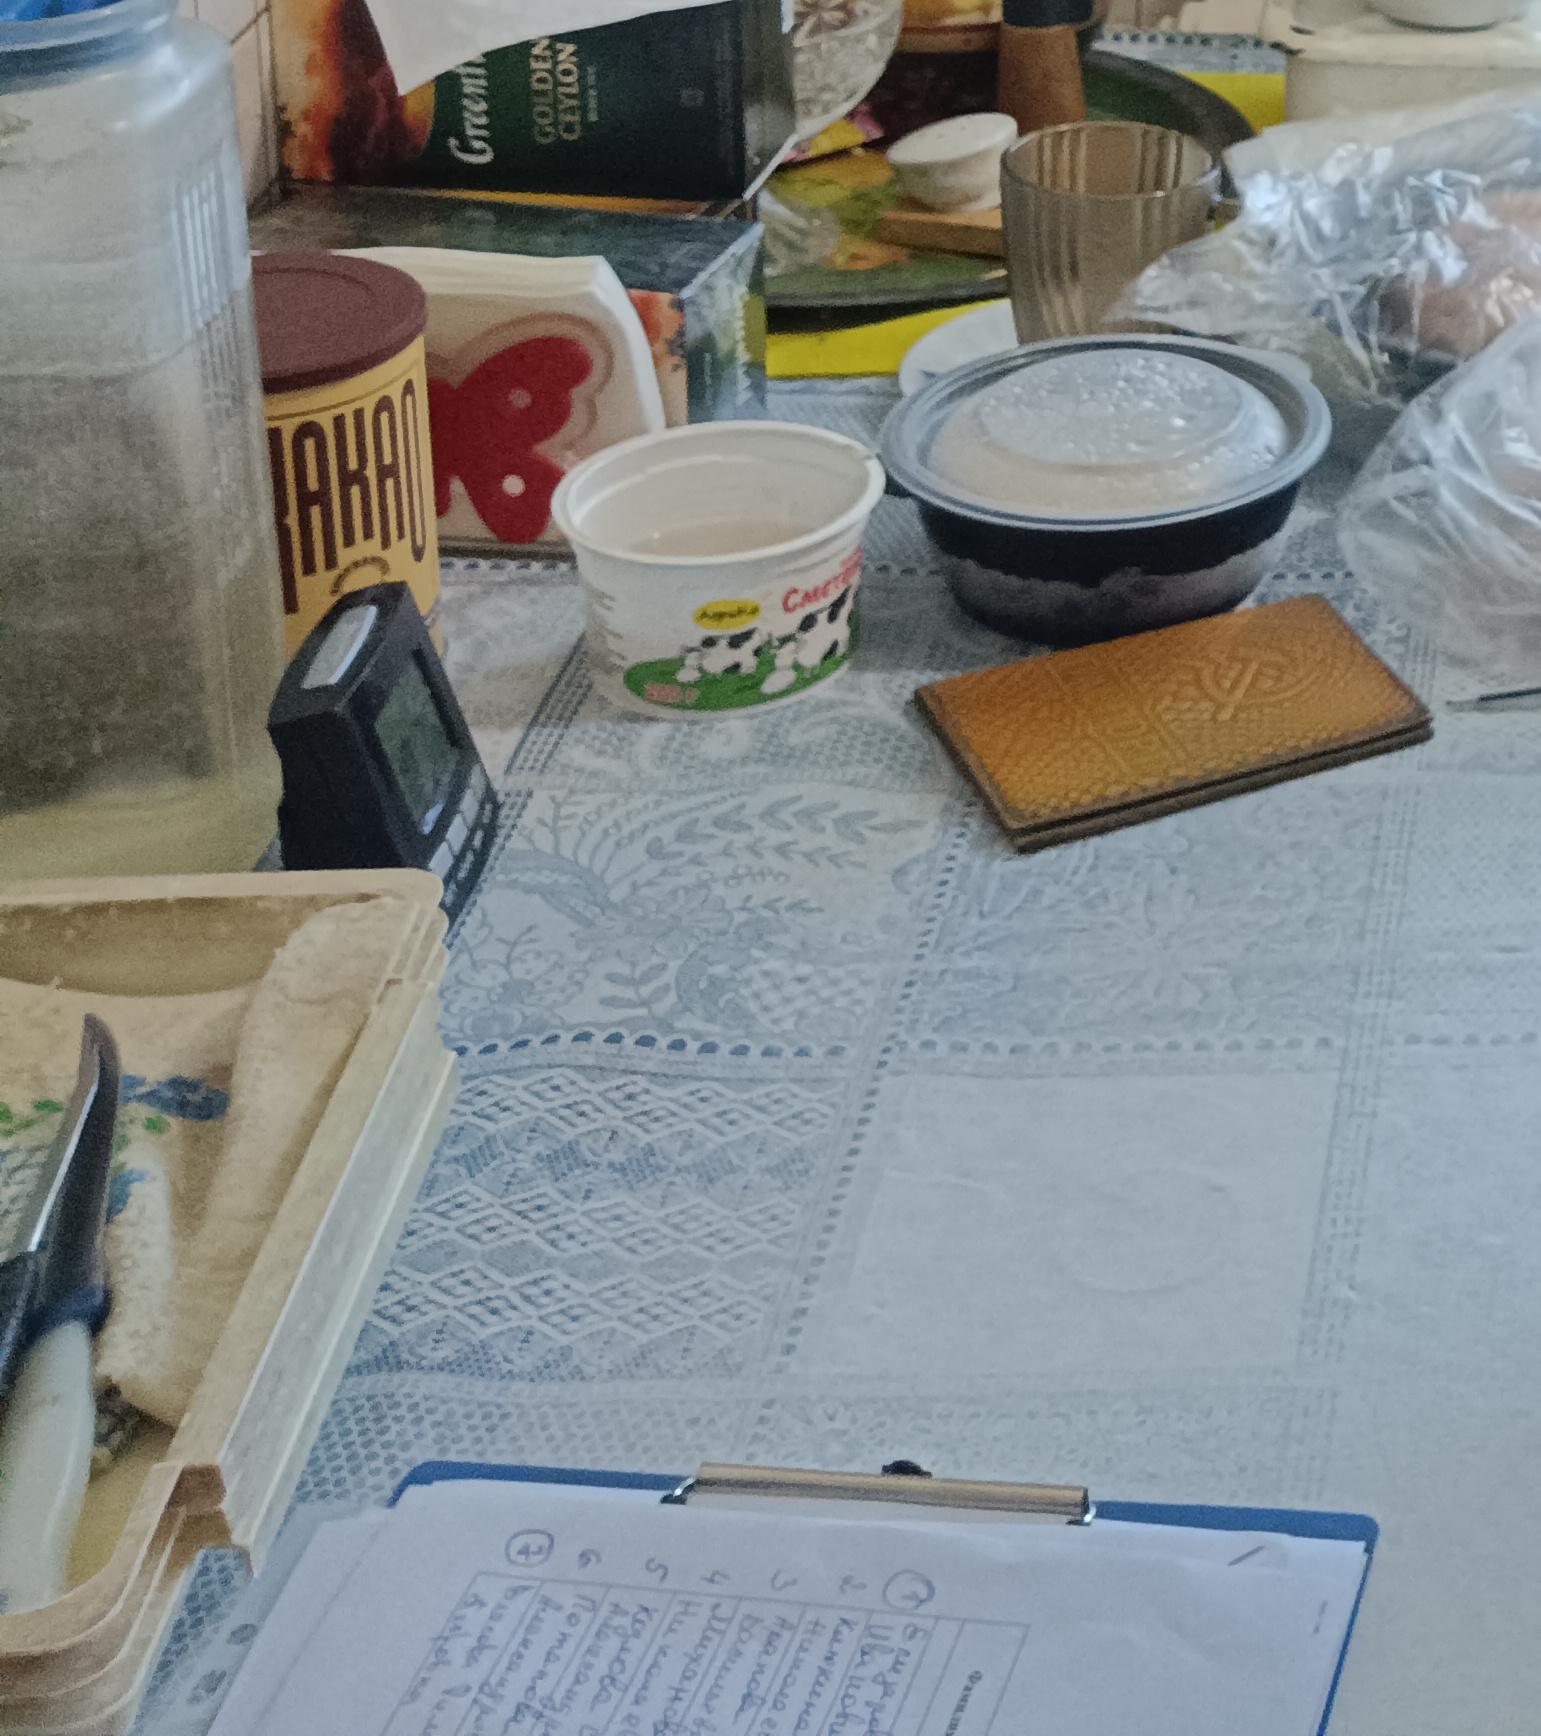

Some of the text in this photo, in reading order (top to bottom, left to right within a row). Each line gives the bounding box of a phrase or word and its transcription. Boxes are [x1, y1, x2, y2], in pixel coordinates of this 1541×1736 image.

[447, 50, 495, 165] Greenf
[530, 36, 557, 145] GOLDEN
[555, 41, 582, 140] CEYLON
[758, 1616, 828, 1736] Николае
